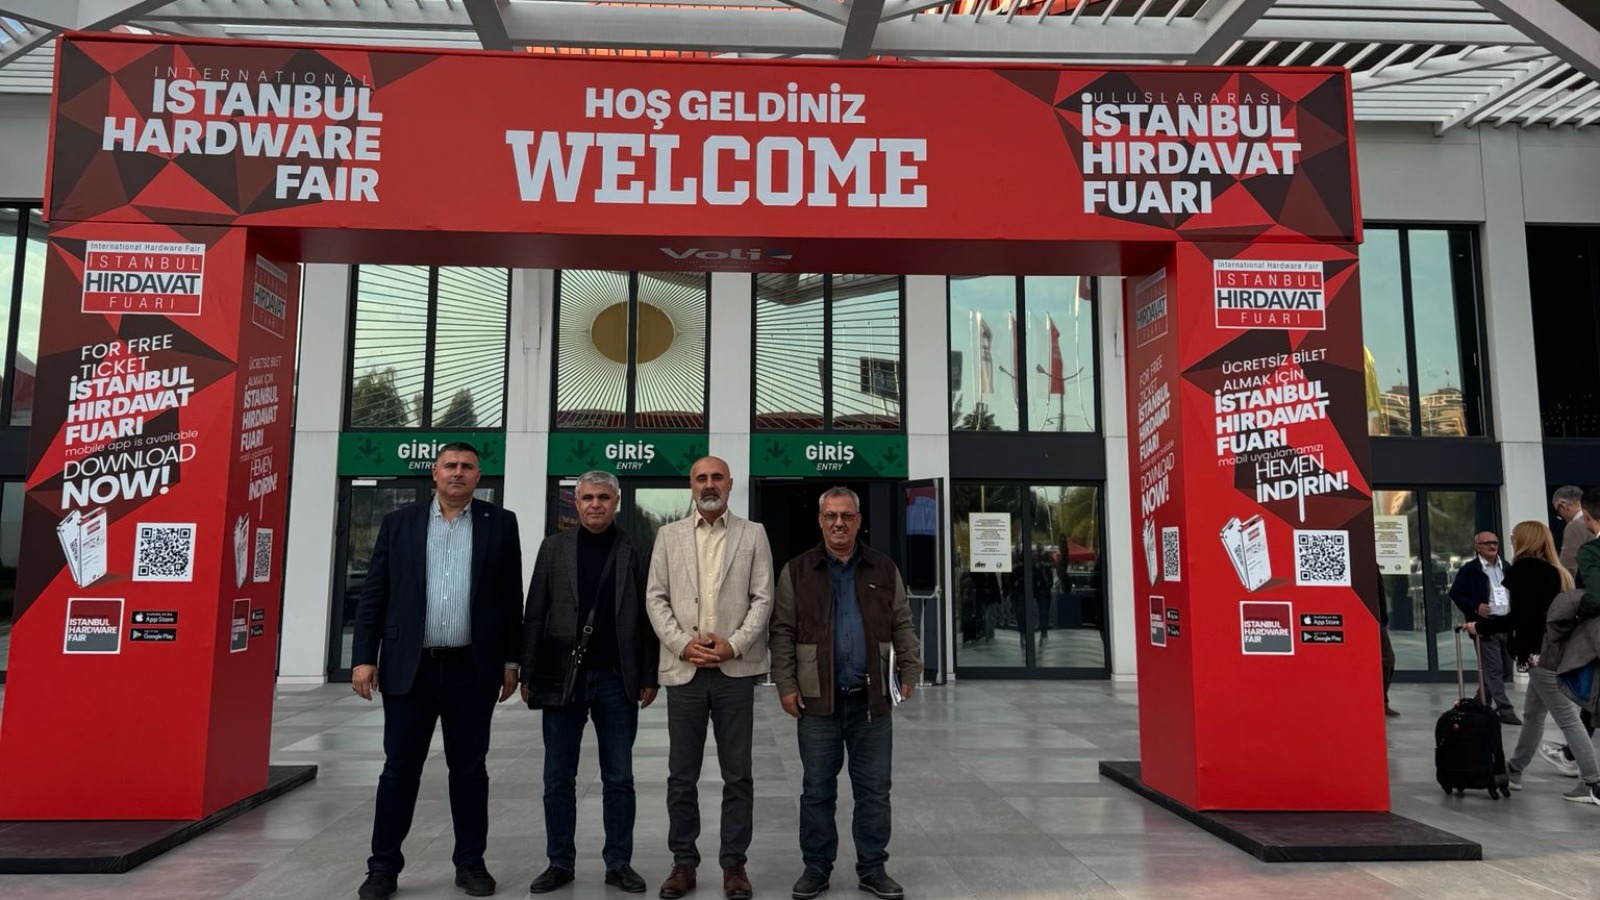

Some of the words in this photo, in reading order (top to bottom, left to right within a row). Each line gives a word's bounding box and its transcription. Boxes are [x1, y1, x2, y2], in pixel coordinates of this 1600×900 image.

[154, 66, 371, 86] INTERNATIONAL
[585, 87, 672, 130] HOŞ
[678, 82, 866, 124] GELDİNİZ
[1094, 92, 1281, 104] ULUSLARARASI
[1081, 92, 1295, 138] İSTANBUL
[102, 116, 381, 161] HARDWARE
[505, 130, 928, 208] WELCOME
[1082, 142, 1302, 175] HIRDAVAT
[275, 165, 380, 202] FAIR
[1083, 180, 1213, 214] FUARI
[91, 242, 142, 251] International
[145, 243, 182, 252] Hardware
[185, 244, 201, 252] Fair
[1217, 261, 1265, 269] International
[1267, 262, 1302, 270] Hardware
[85, 272, 201, 294] HIRDAVAT
[109, 296, 174, 309] FUARI
[1217, 289, 1322, 310] HIRDAVAT
[1241, 312, 1301, 324] FUARI
[81, 341, 121, 361] FOR
[127, 334, 173, 354] FREE
[80, 355, 150, 379] TICKET
[1222, 353, 1289, 375] ÜCRETSİZ
[1292, 348, 1327, 365] BİLET
[68, 366, 195, 401] İSTANBUL
[1223, 373, 1271, 392] ALMAK
[1274, 367, 1304, 385] İÇİN
[67, 386, 195, 424] HIRDAVAT
[1214, 379, 1329, 414] İSTANBUL
[1216, 400, 1330, 435] HIRDAVAT
[65, 416, 144, 445] FUARI
[65, 444, 105, 457] mobile
[107, 439, 132, 452] app
[134, 437, 143, 447] is
[145, 429, 199, 446] available
[240, 428, 265, 452] FUARI
[1217, 427, 1287, 456] FUARI
[63, 443, 197, 480] DOWNLOAD
[397, 439, 447, 459] GİRİ
[605, 440, 655, 463] GİRİŞ
[805, 440, 855, 464] GİRİŞ
[1218, 454, 1248, 466] mobil
[616, 461, 643, 470] ENTRY
[816, 462, 843, 471] ENTRY
[1255, 452, 1325, 480] HEMEN
[61, 465, 171, 510] NOW!
[1142, 473, 1170, 519] NOW!
[1256, 469, 1349, 523] İNDİRİN!
[67, 634, 87, 642] FAIR
[68, 626, 117, 634] HARDWARE
[143, 633, 162, 641] Google
[1244, 628, 1289, 636] HARDWARE
[1244, 635, 1262, 643] FAIR
